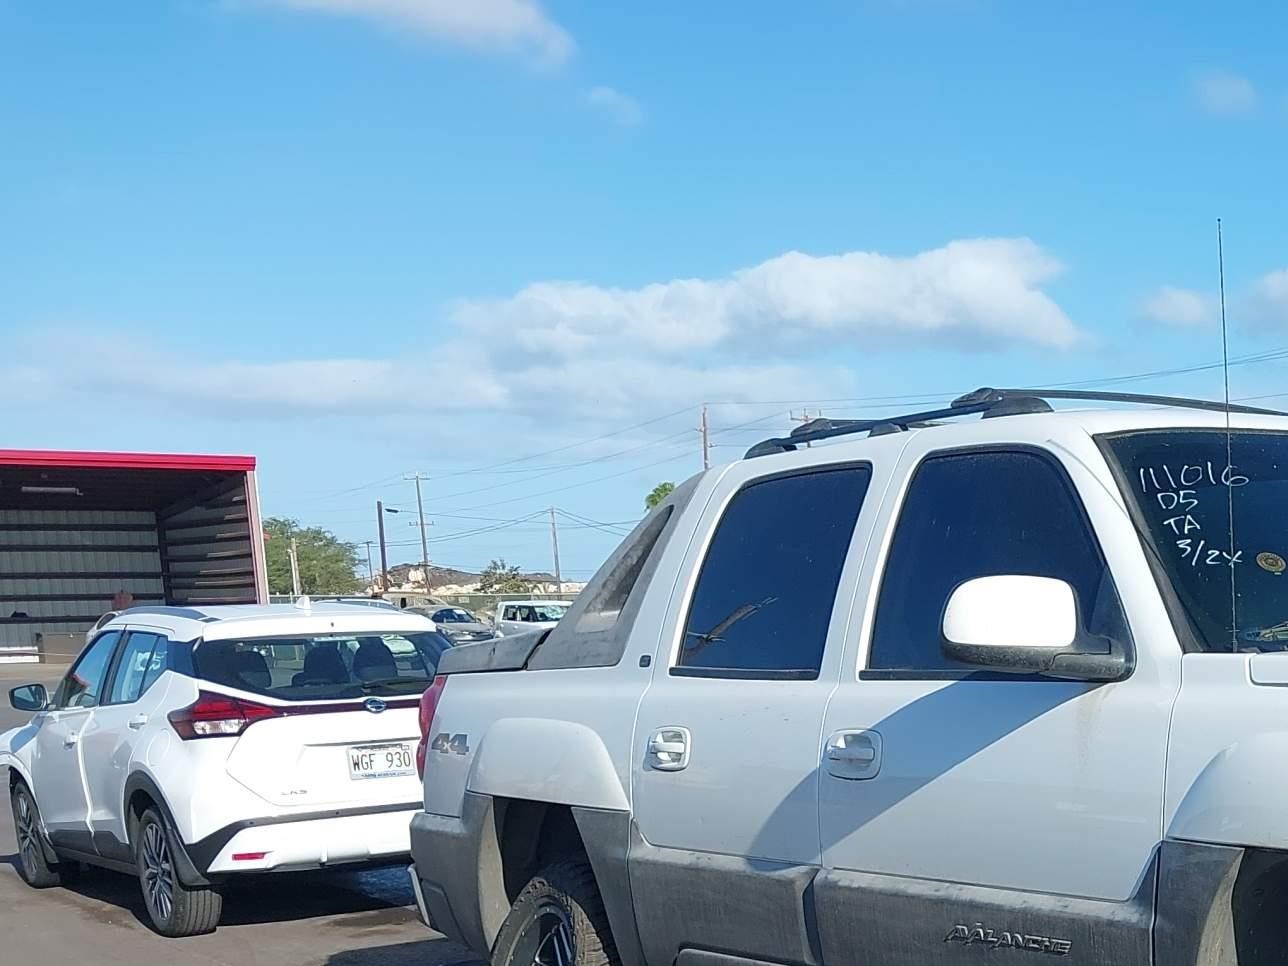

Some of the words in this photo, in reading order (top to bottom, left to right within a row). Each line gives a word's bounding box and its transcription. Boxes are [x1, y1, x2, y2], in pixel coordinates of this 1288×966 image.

[1140, 461, 1249, 492] 111016
[1156, 489, 1199, 511] D5
[1163, 514, 1201, 535] TA
[351, 753, 377, 771] WGF
[385, 751, 411, 768] 930
[944, 921, 1072, 956] AVALANCHE
